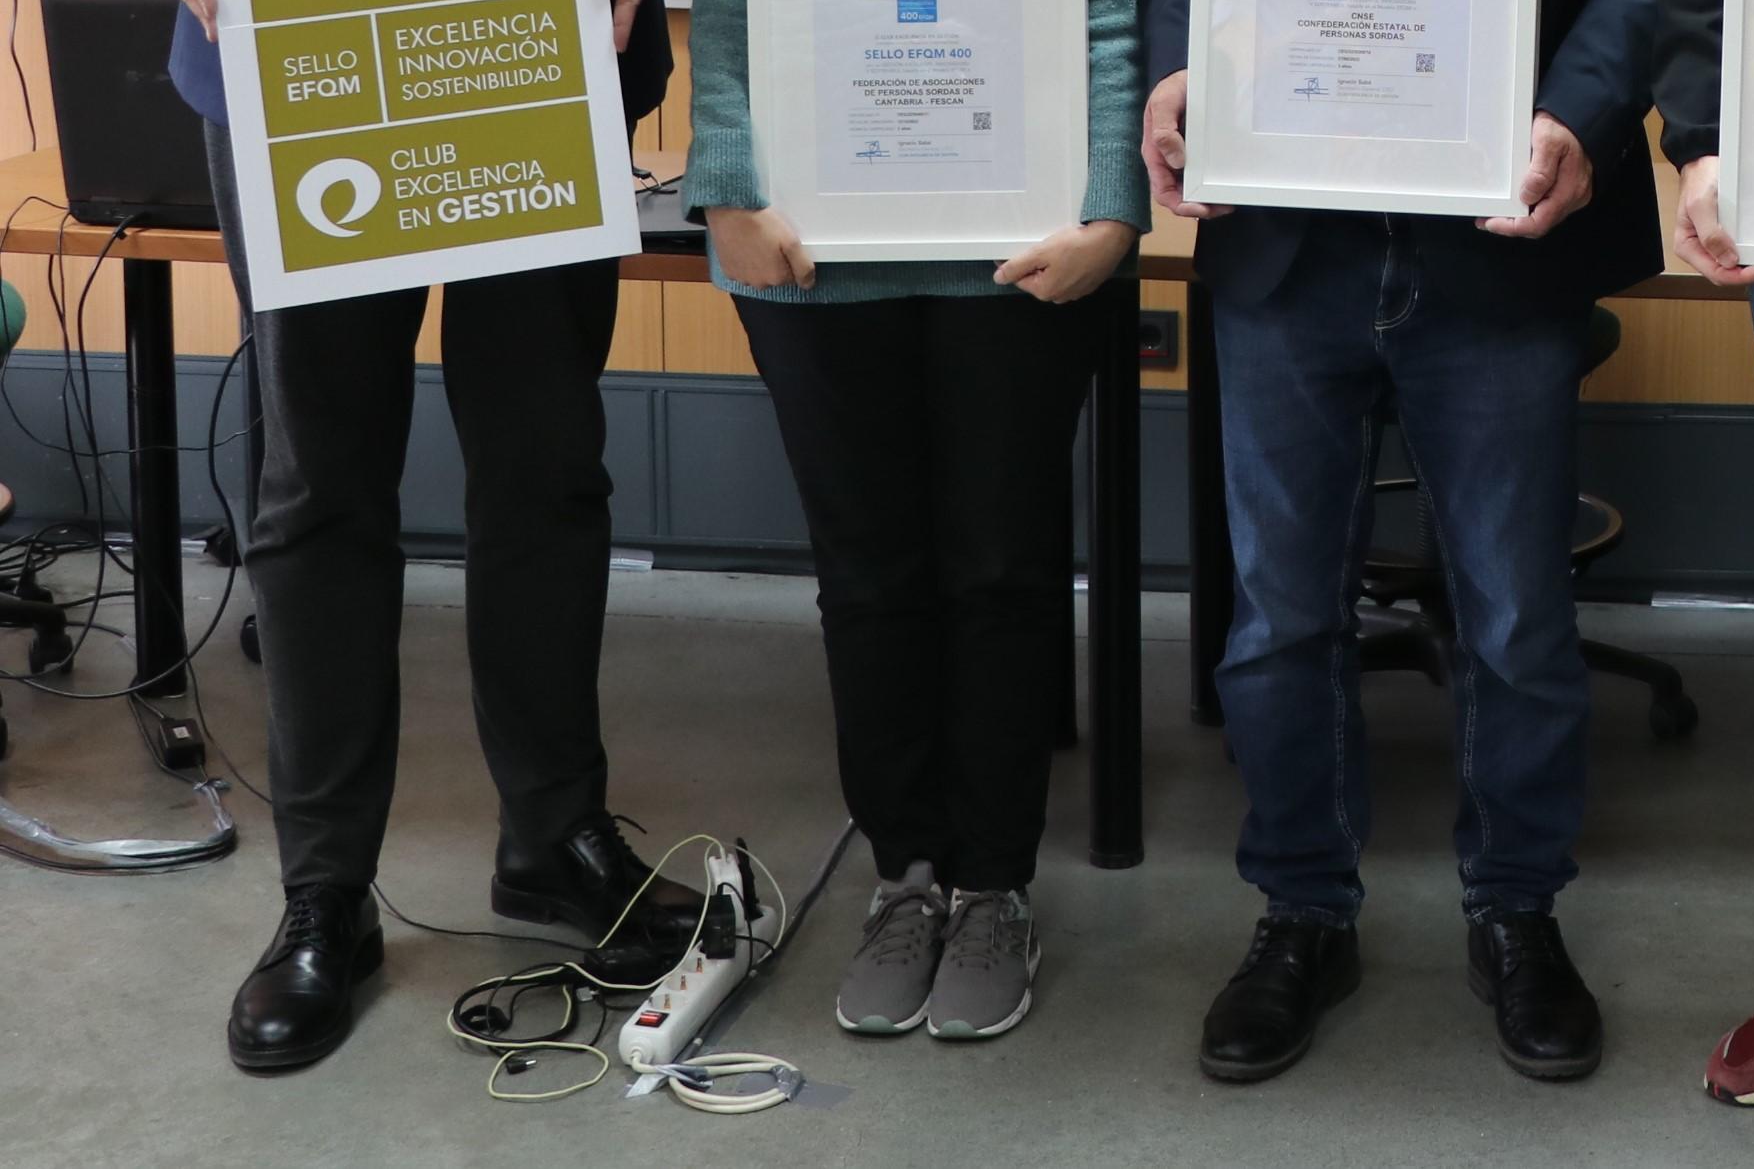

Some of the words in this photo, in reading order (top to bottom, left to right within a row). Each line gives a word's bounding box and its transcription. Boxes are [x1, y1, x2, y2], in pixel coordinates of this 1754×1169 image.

[394, 12, 557, 50] EXCELENCIA
[1298, 20, 1370, 30] CONFEDERACIÓN
[1373, 23, 1411, 31] ESTATAL
[1320, 30, 1367, 39] PERSONAS
[1369, 32, 1405, 40] SORDAS
[283, 50, 357, 77] SELLO
[397, 37, 559, 76] INNOVACIÓN
[865, 49, 904, 60] SELLO
[908, 48, 945, 58] EFQM
[950, 48, 972, 58] 400
[286, 75, 361, 103] EFQM
[401, 64, 562, 101] SOSTENIBILIDAD
[853, 78, 906, 87] FEDERACIÓN
[923, 78, 985, 86] ASOCIACIONES
[390, 144, 457, 170] CLUB
[394, 161, 545, 200] EXCELENCIA
[398, 207, 431, 230] EN
[436, 179, 576, 224] GESTIÓN
